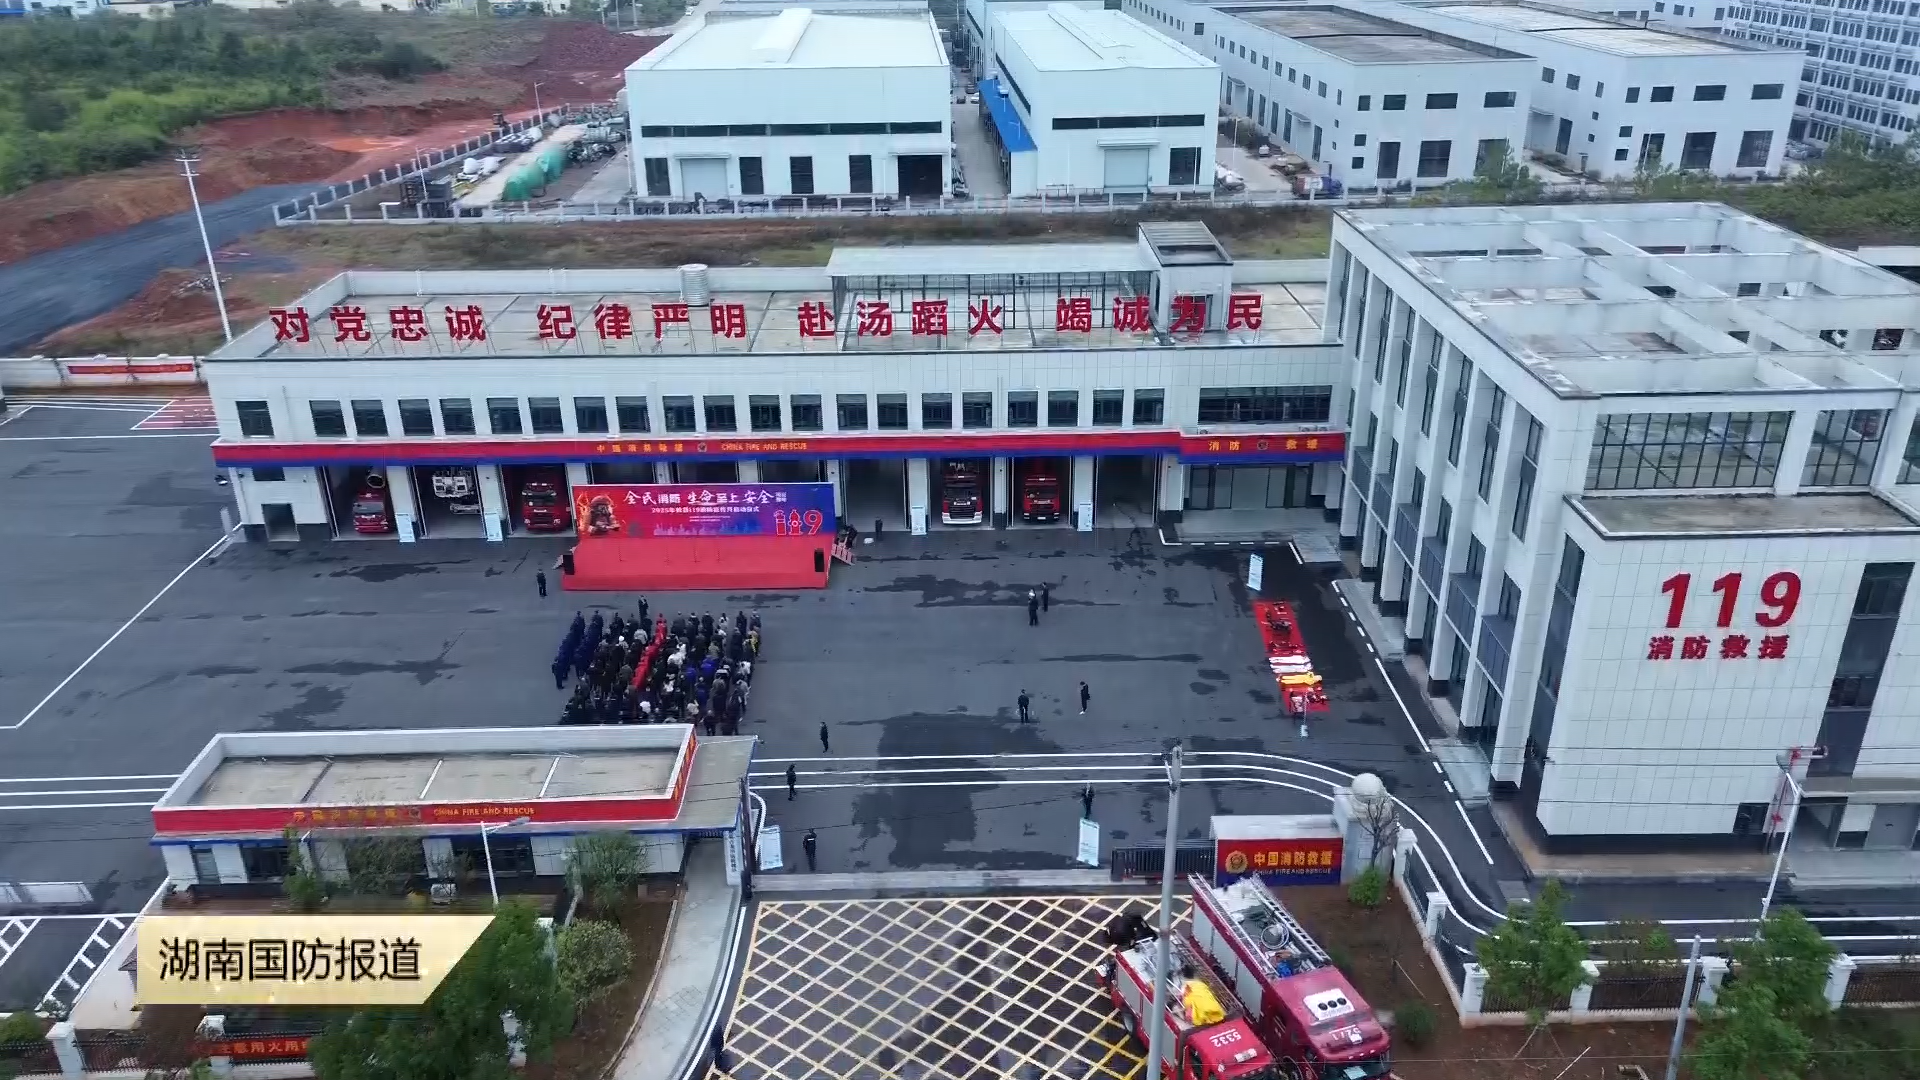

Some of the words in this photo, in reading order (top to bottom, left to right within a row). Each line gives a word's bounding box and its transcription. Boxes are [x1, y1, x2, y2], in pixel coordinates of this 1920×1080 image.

[268, 304, 487, 342] 对党忠诚
[536, 303, 747, 341] 纪律严明
[797, 297, 1003, 338] 赴汤蹈火
[1056, 294, 1264, 333] 竭诚为民
[762, 443, 778, 451] AND
[1208, 440, 1240, 451] 消防
[624, 490, 681, 505] 全民消防
[687, 490, 740, 506] 生命至上
[742, 490, 775, 504] 安全
[1661, 571, 1802, 628] 119
[1647, 633, 1791, 660] 消防救援
[433, 808, 459, 816] CHINA
[462, 808, 480, 816] FIRE
[483, 807, 501, 815] AND
[503, 806, 535, 815] RESCUE
[1253, 850, 1333, 866] 中国消防救援
[1211, 1030, 1242, 1048] 5332
